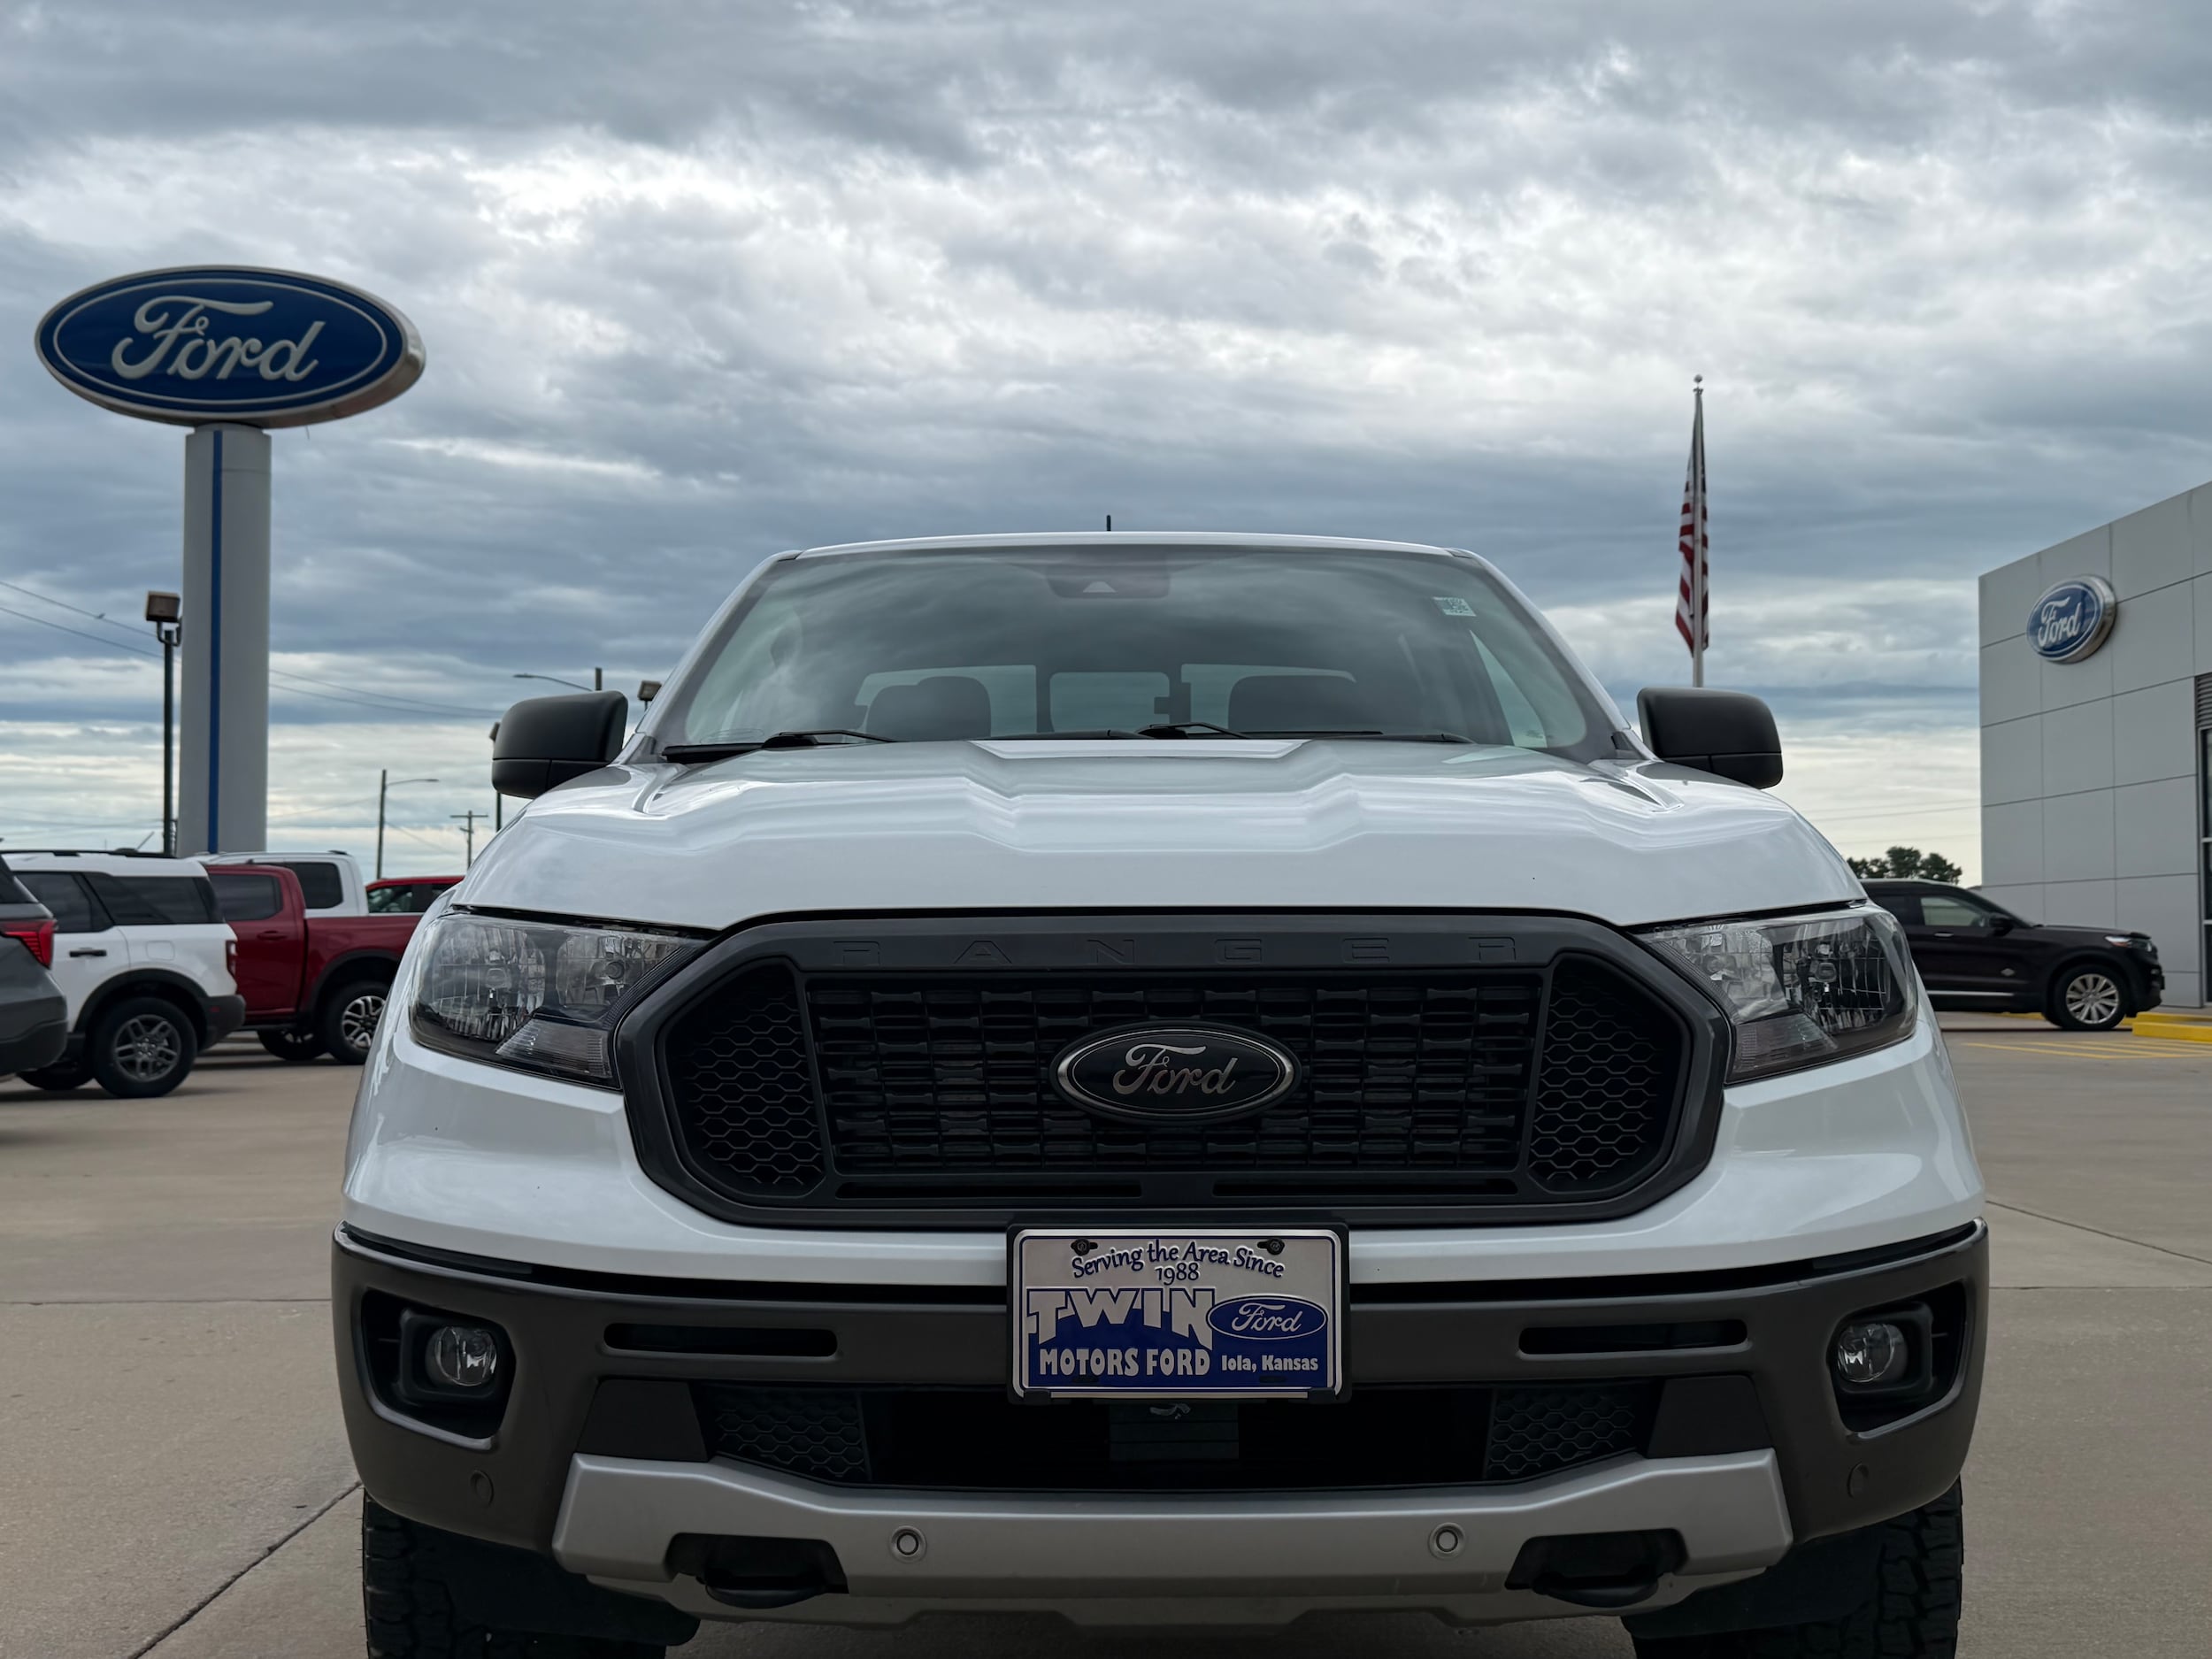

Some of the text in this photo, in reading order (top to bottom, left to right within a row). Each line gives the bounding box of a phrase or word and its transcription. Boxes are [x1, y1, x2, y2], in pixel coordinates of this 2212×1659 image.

[111, 295, 326, 382] Ford
[2038, 595, 2083, 648] Ford
[833, 935, 1518, 965] RANGER
[1112, 1042, 1238, 1095] Ford
[1071, 1239, 1286, 1279] Serving the Area Since
[1155, 1263, 1201, 1286] 1988
[1025, 1287, 1216, 1351] TWIN
[1231, 1302, 1303, 1333] Ford
[1038, 1348, 1211, 1377] MOTORS FORD
[1221, 1355, 1319, 1373] Iola, Kansas
